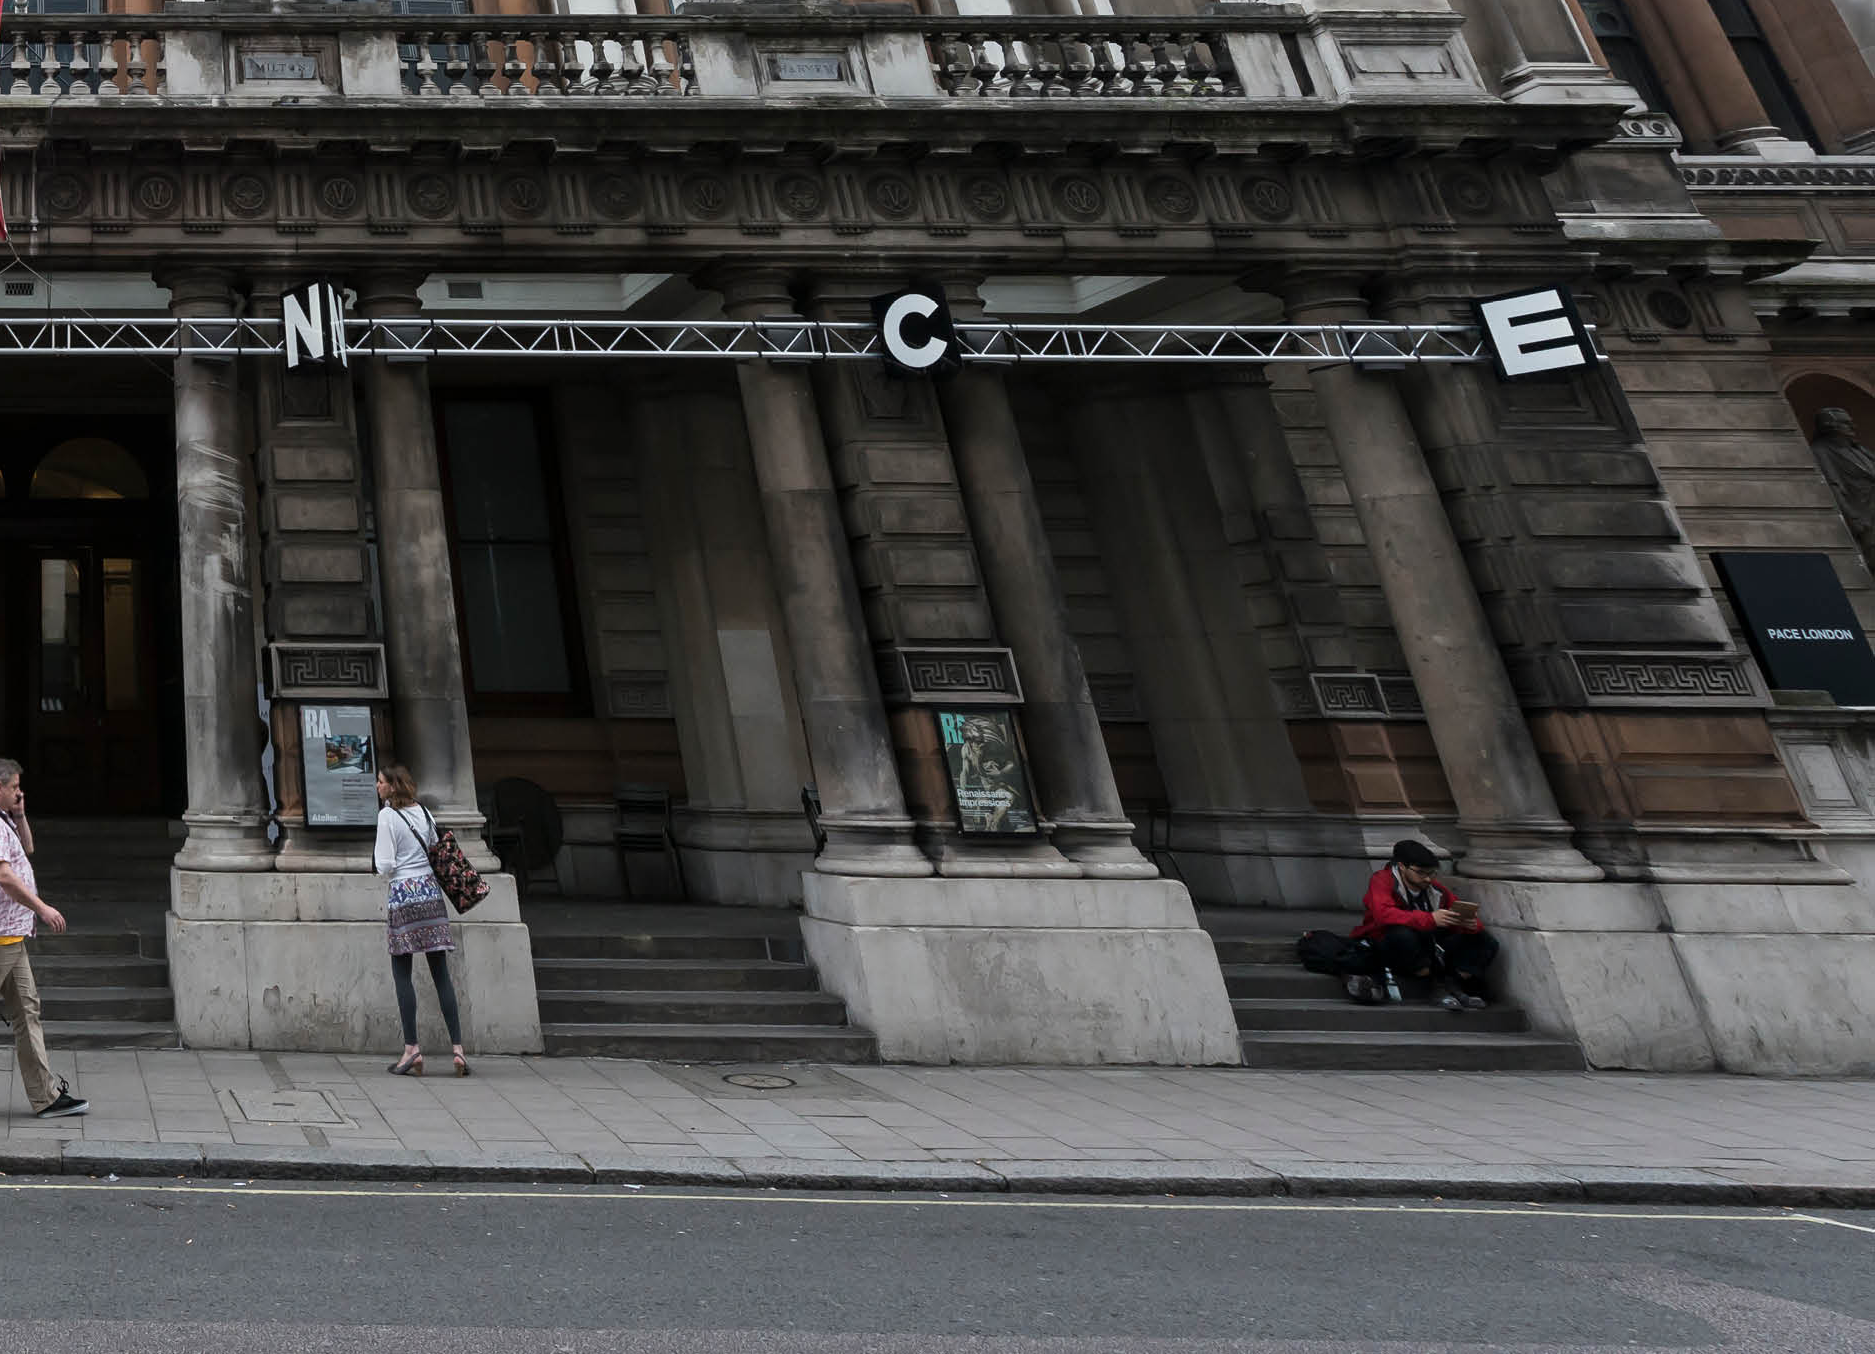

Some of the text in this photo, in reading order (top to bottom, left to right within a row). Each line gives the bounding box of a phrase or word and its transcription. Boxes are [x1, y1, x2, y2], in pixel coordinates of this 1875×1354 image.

[883, 294, 947, 368] C
[1481, 289, 1586, 376] E
[1767, 628, 1854, 640] PACE LONDON
[305, 709, 331, 738] RA
[957, 789, 1013, 799] Renaissance
[958, 798, 1011, 809] Impressions
